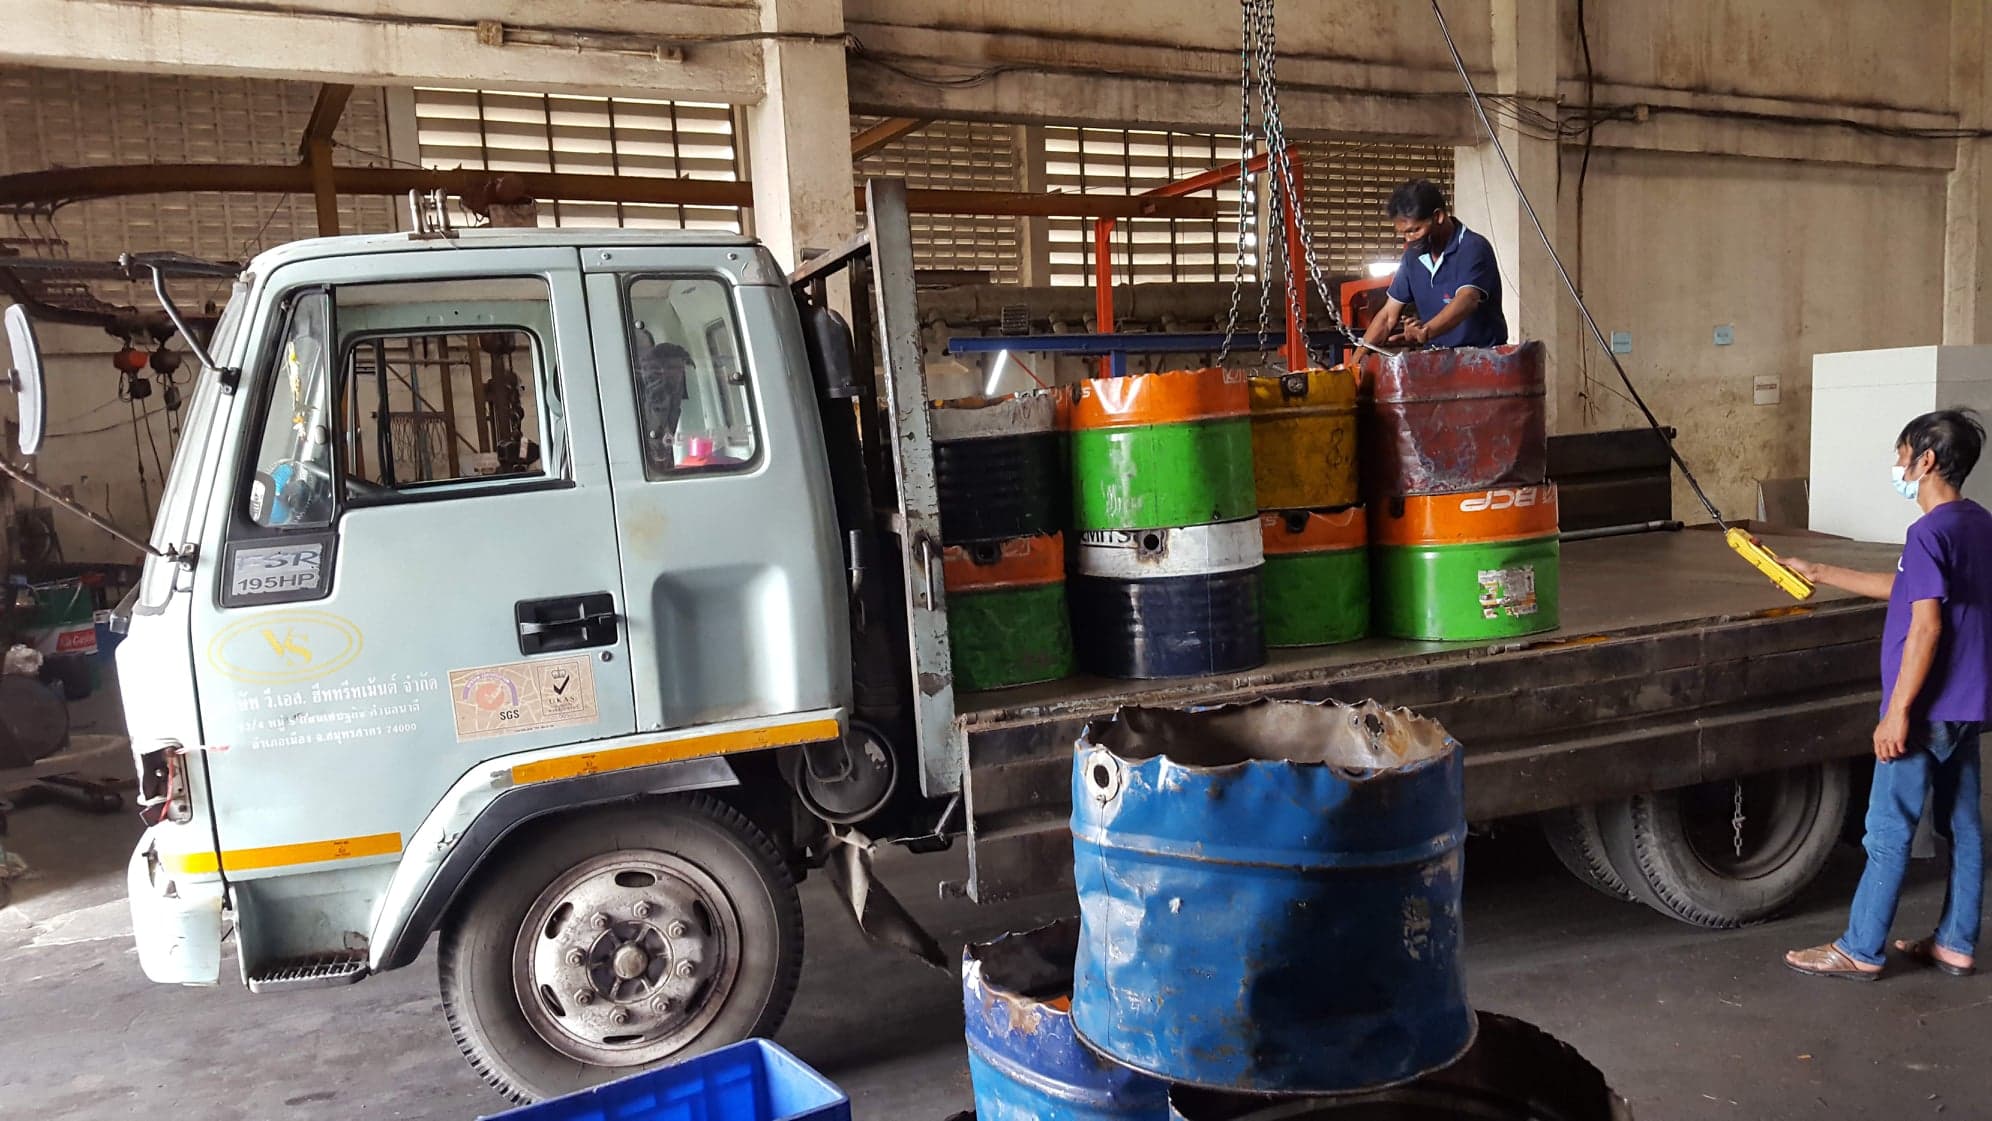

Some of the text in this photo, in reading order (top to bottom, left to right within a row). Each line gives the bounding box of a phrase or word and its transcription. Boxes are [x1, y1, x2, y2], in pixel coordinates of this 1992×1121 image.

[1460, 486, 1537, 512] BCP
[238, 573, 315, 591] 195HP
[402, 671, 438, 693] จำกัด
[499, 709, 520, 721] SGS
[385, 722, 417, 733] 74000
